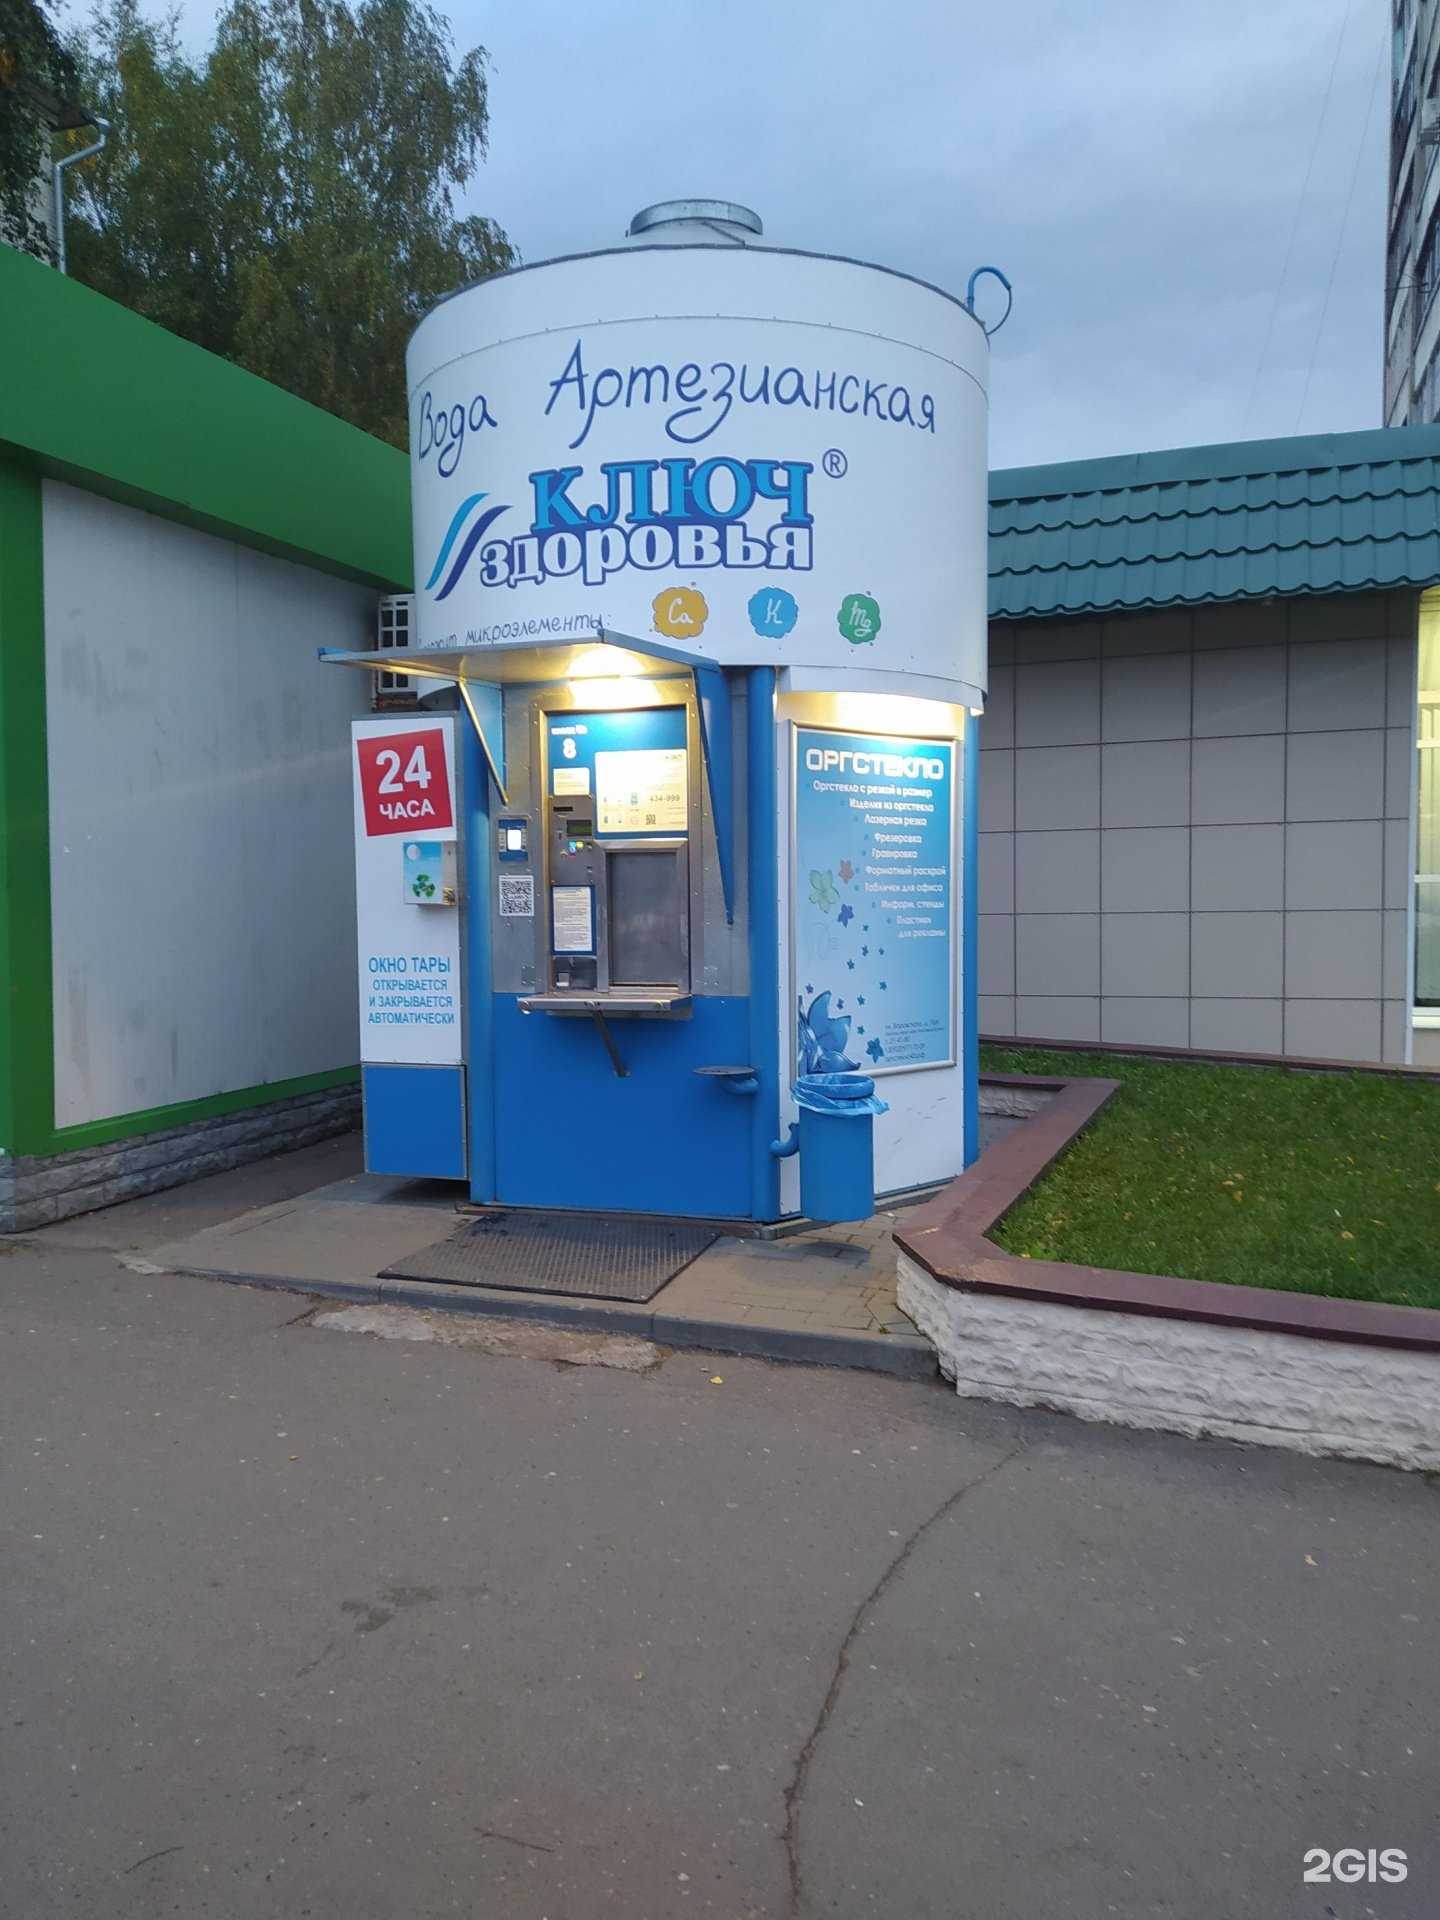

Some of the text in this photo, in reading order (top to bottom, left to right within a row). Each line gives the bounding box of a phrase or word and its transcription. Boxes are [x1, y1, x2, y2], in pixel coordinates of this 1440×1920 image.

[418, 338, 936, 478] Вода Артезианская
[528, 456, 814, 534] КЛЮЧ
[667, 598, 694, 624] Ca
[375, 745, 431, 795] 24
[806, 748, 945, 780] ОРГСТЕКЛО
[813, 780, 859, 792] Оргстекло
[379, 799, 436, 821] ЧАСА
[368, 956, 451, 973] ОКНО ТАРЫ
[372, 979, 448, 991] ОТКРЫВАЕТСЯ
[368, 995, 453, 1008] И ЗАКРЫВАЕТСЯ
[368, 1012, 455, 1024] АВТОМАТИЧЕСКИ
